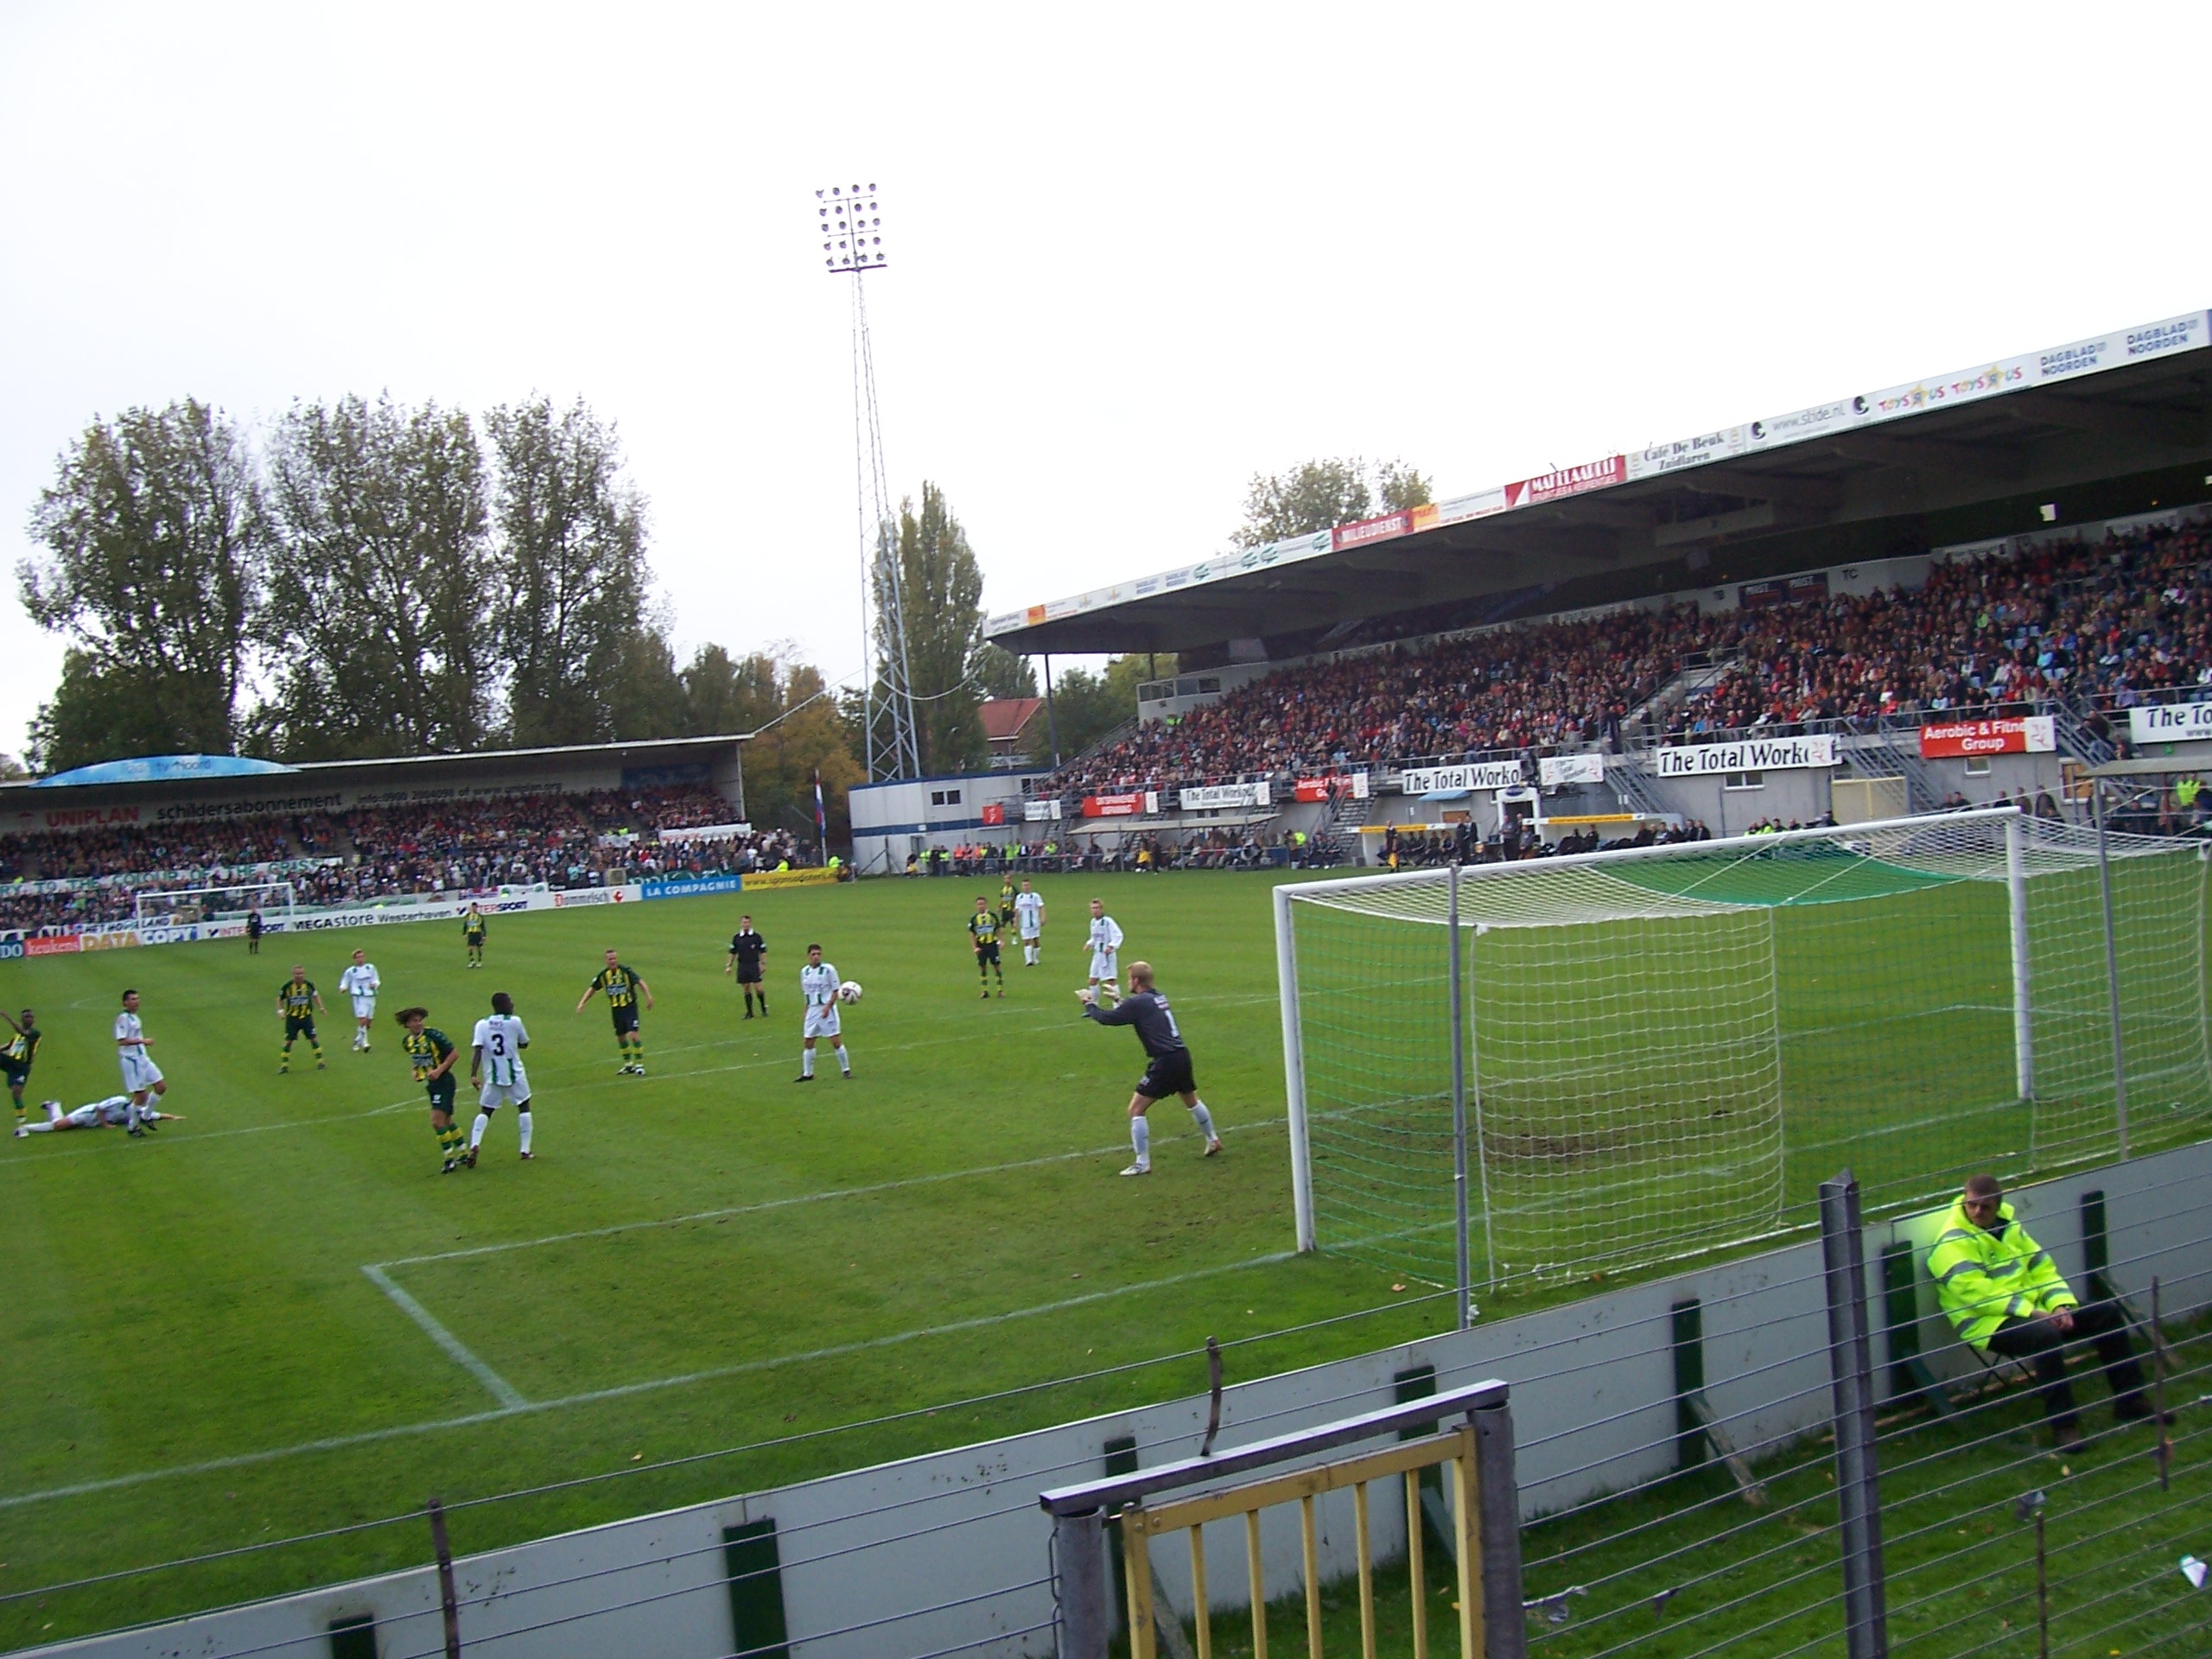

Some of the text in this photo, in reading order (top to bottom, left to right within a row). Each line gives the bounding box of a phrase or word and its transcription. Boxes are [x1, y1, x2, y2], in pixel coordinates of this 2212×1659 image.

[2127, 321, 2187, 345] DAGBLAD
[2127, 333, 2188, 356] NOORDEN
[2040, 345, 2096, 366] DAGBLAD
[2041, 355, 2098, 378] NOORDEN
[1951, 376, 1985, 394] TOYS
[2005, 366, 2023, 382] US
[1878, 395, 1910, 412] TOYS
[1929, 386, 1944, 400] US
[1673, 442, 1689, 455] De
[2147, 708, 2185, 728] The
[1924, 724, 1977, 741] Aerobic
[1979, 722, 1990, 735] &
[1961, 737, 2005, 752] Group
[1661, 751, 1694, 772] The
[1699, 746, 1745, 770] Total
[1406, 772, 1430, 791] The
[1433, 769, 1467, 790] Total
[46, 806, 141, 827] UNIPLAN
[157, 792, 342, 819] schildersabonnement
[647, 880, 736, 897] LA COMPAGNIE
[82, 931, 140, 951] DATA
[143, 926, 193, 944] COPY
[491, 1033, 505, 1056] 3
